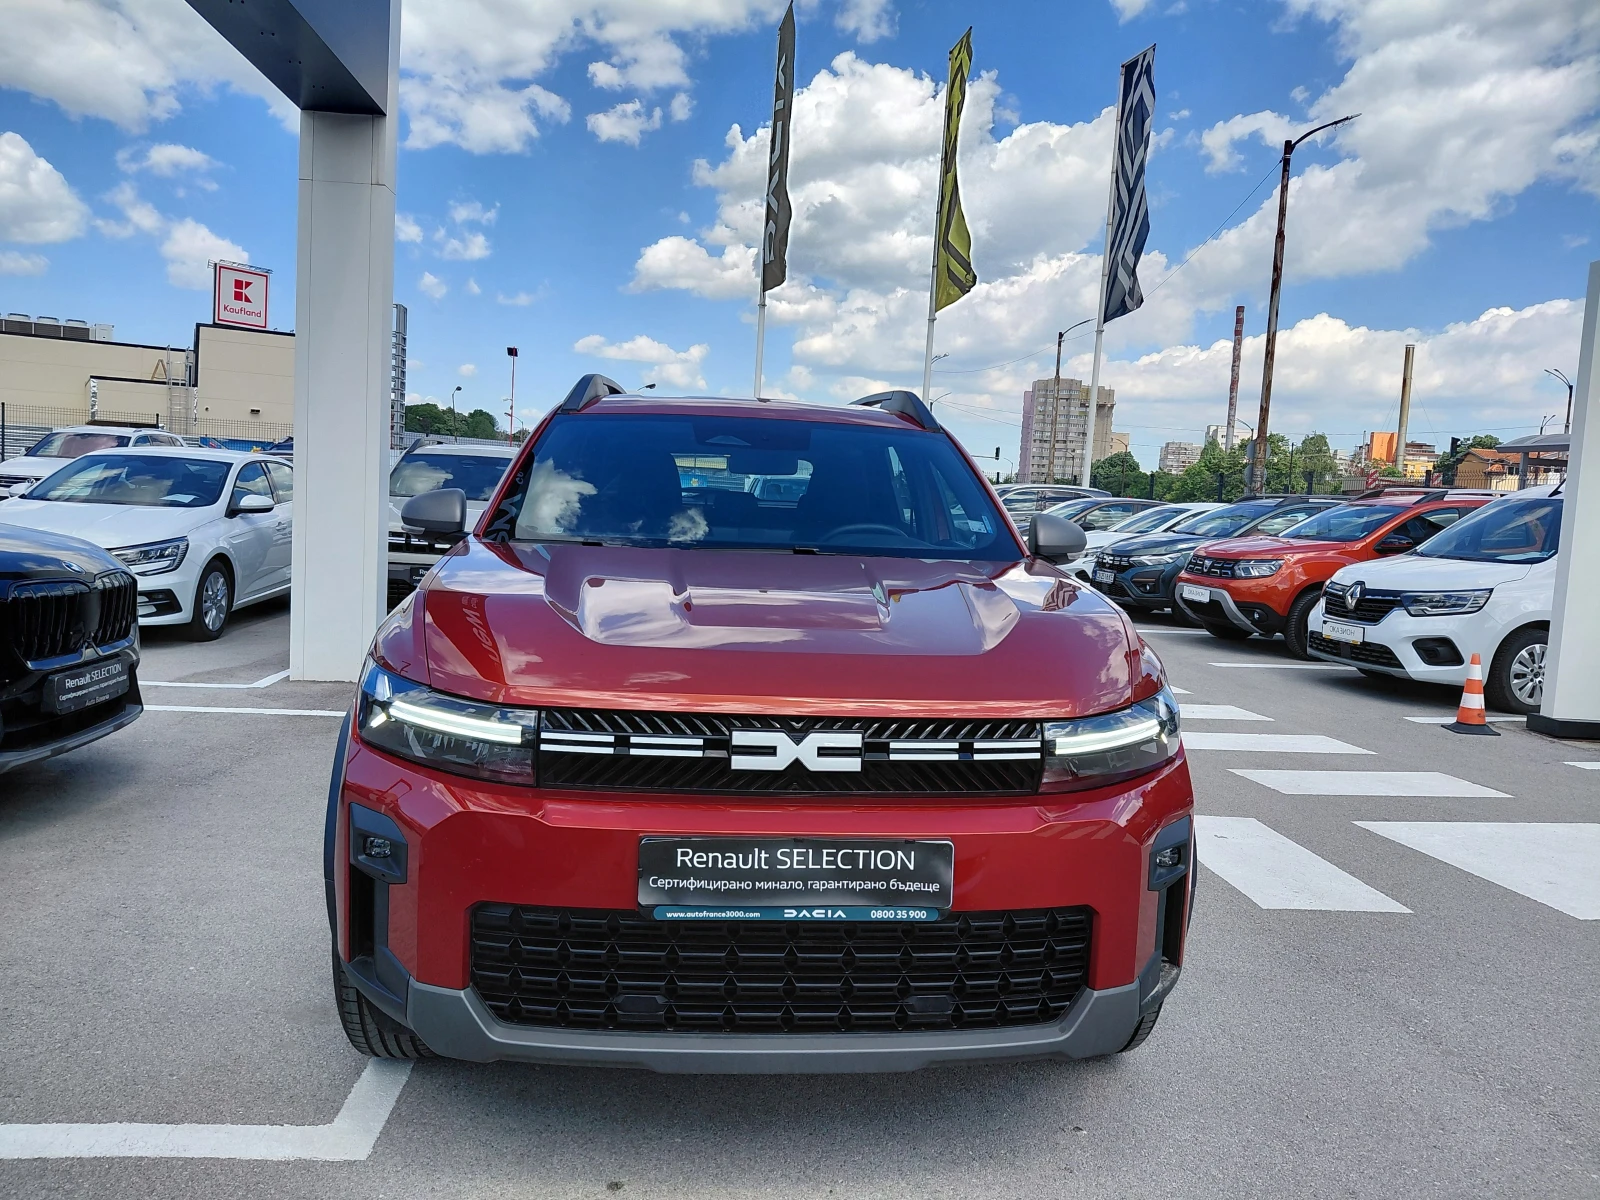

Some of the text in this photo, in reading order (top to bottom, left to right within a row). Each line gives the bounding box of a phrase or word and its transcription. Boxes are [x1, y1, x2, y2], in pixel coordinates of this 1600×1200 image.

[223, 304, 261, 317] Kaufland
[65, 673, 91, 689] Renault
[91, 663, 122, 681] SELECTION
[676, 847, 915, 871] Renault SELECTION
[649, 876, 940, 892] Сертифицирано минало, гарантирано бъдеще
[666, 910, 761, 919] www.autofrance3000.com
[784, 909, 846, 918] DACIA
[870, 910, 927, 919] 0800 35 900
